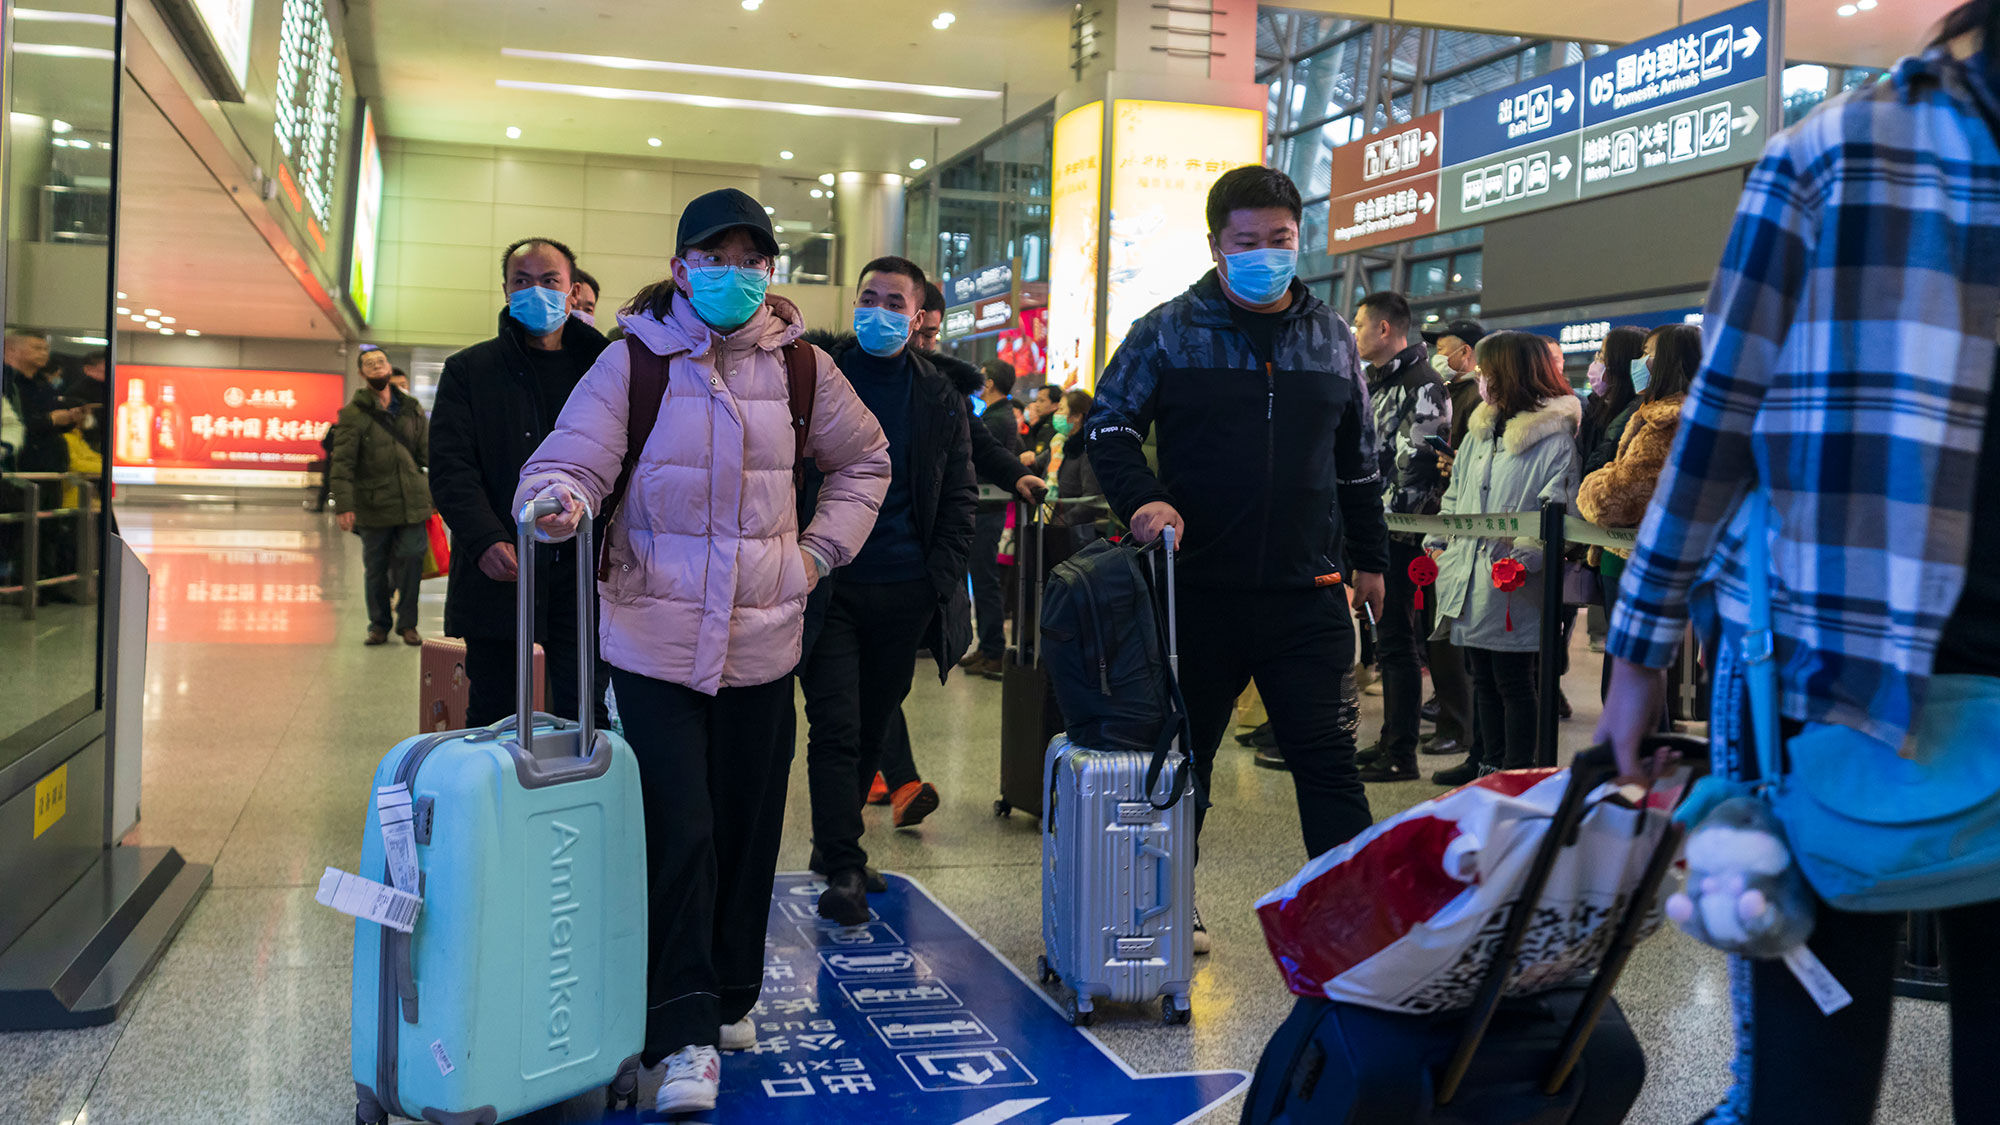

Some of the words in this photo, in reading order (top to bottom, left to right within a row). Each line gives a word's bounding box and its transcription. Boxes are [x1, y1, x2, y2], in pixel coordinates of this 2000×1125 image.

[1589, 72, 1615, 106] 05
[1616, 33, 1700, 92] 国内到达
[1613, 82, 1660, 110] Domestic
[1660, 69, 1700, 97] Arrivals
[1497, 93, 1528, 125] 出口
[1508, 119, 1527, 139] Exit
[1639, 121, 1668, 152] 火车
[1642, 149, 1666, 168] Train
[1508, 164, 1522, 195] P
[760, 1019, 836, 1032] Bus
[779, 1057, 865, 1075] Exit
[761, 1073, 876, 1098] 出口
